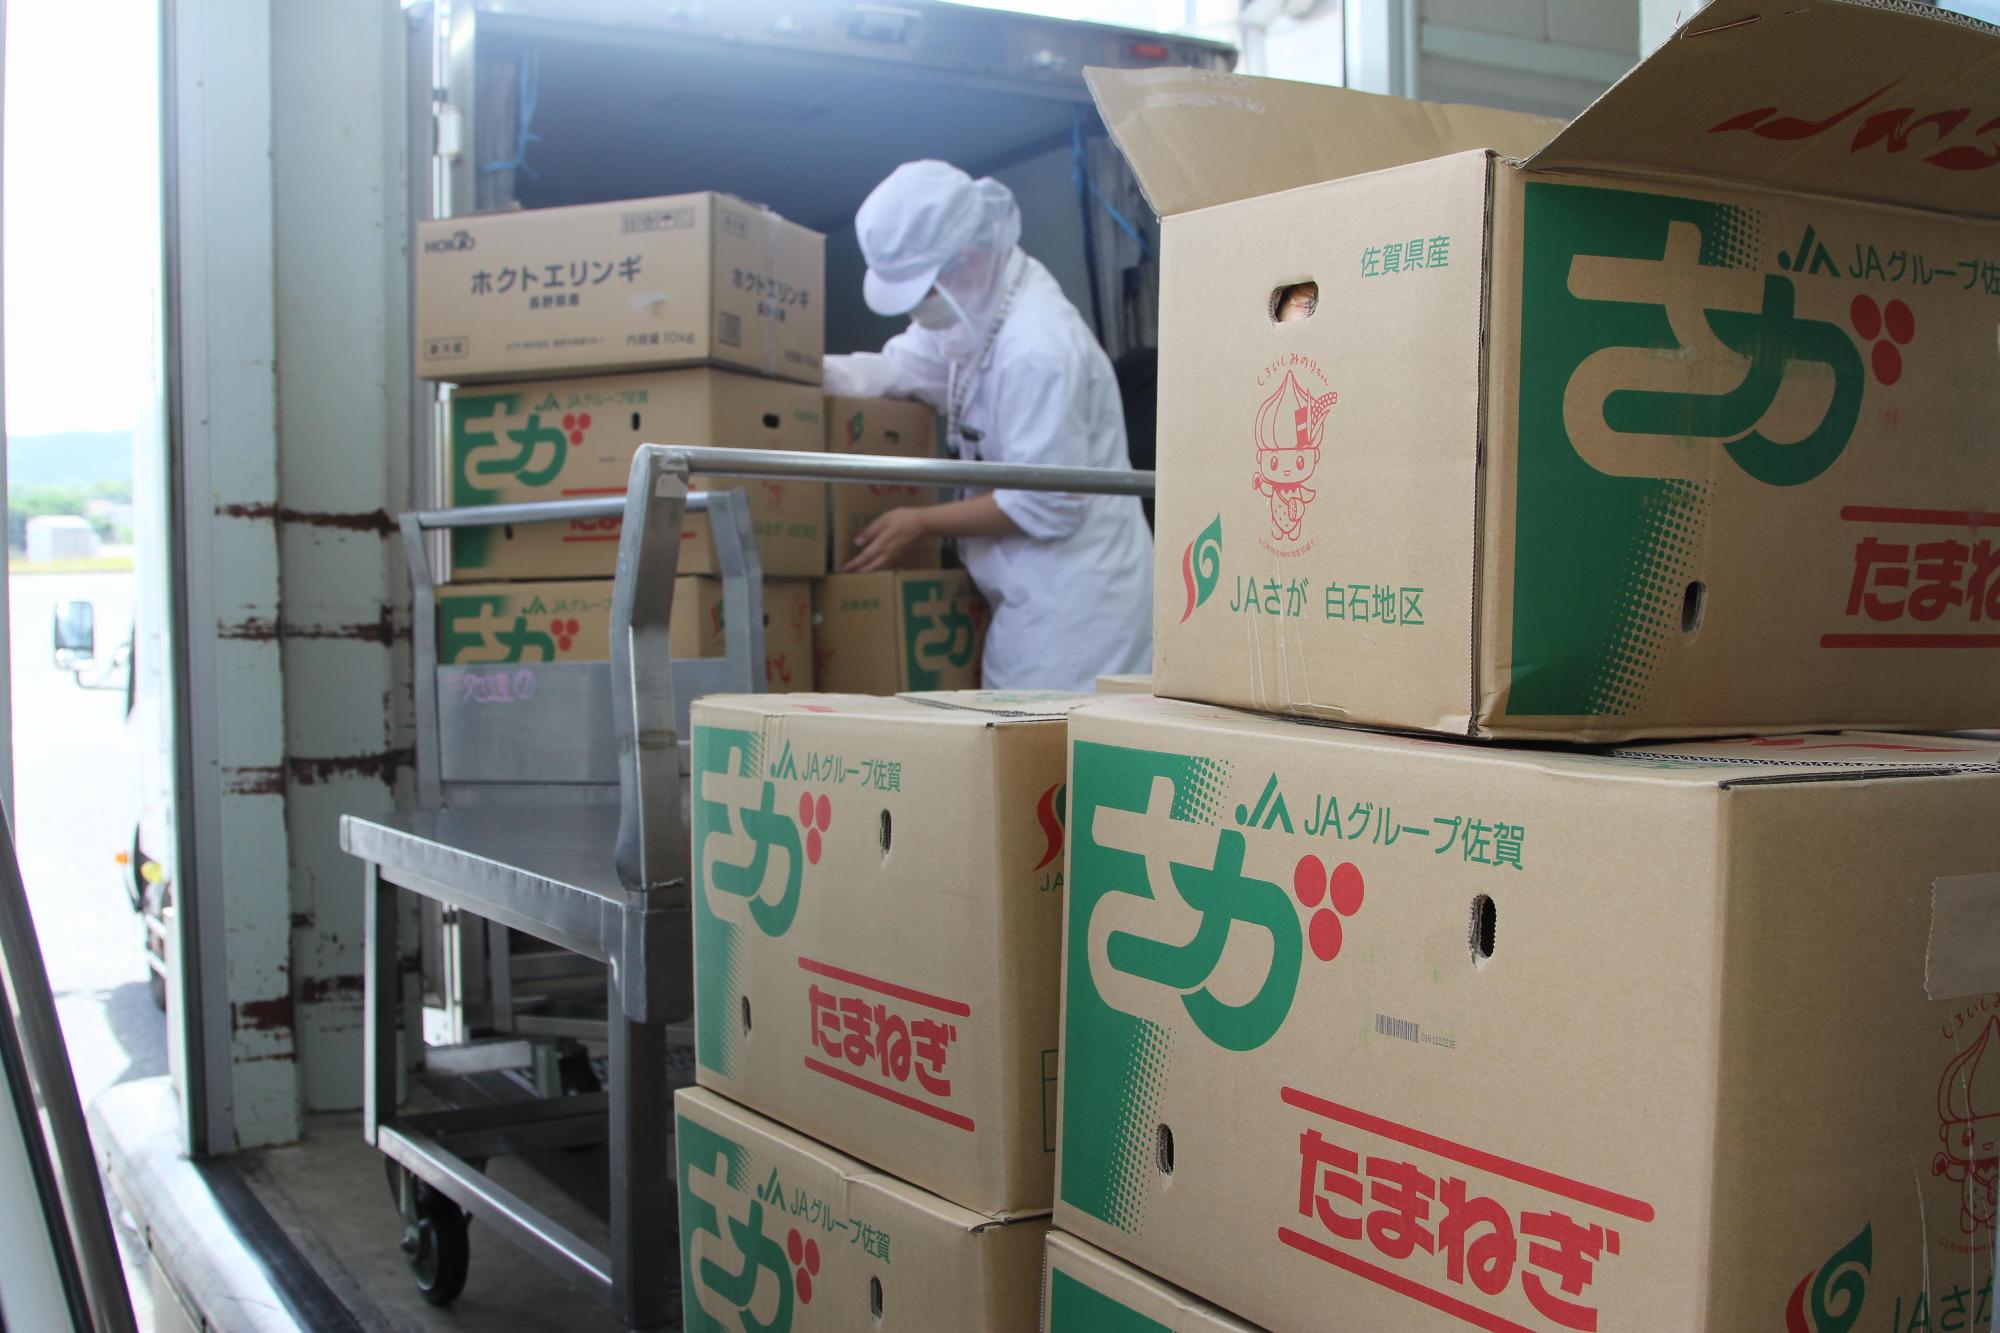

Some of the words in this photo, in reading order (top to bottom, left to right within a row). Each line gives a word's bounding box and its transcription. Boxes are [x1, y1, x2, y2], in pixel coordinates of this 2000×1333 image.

[471, 254, 643, 297] ホクトエリンギ
[1361, 235, 1451, 278] 佐賀県産
[1230, 575, 1309, 618] JAさが
[1325, 581, 1425, 626] 白石地区
[802, 751, 902, 793] JAグループ佐賀
[1303, 794, 1525, 871] JAグループ佐賀
[808, 984, 957, 1097] たまねぎ
[790, 1192, 891, 1264] JAグループ佐賀
[1298, 1128, 1621, 1333] たまねぎ
